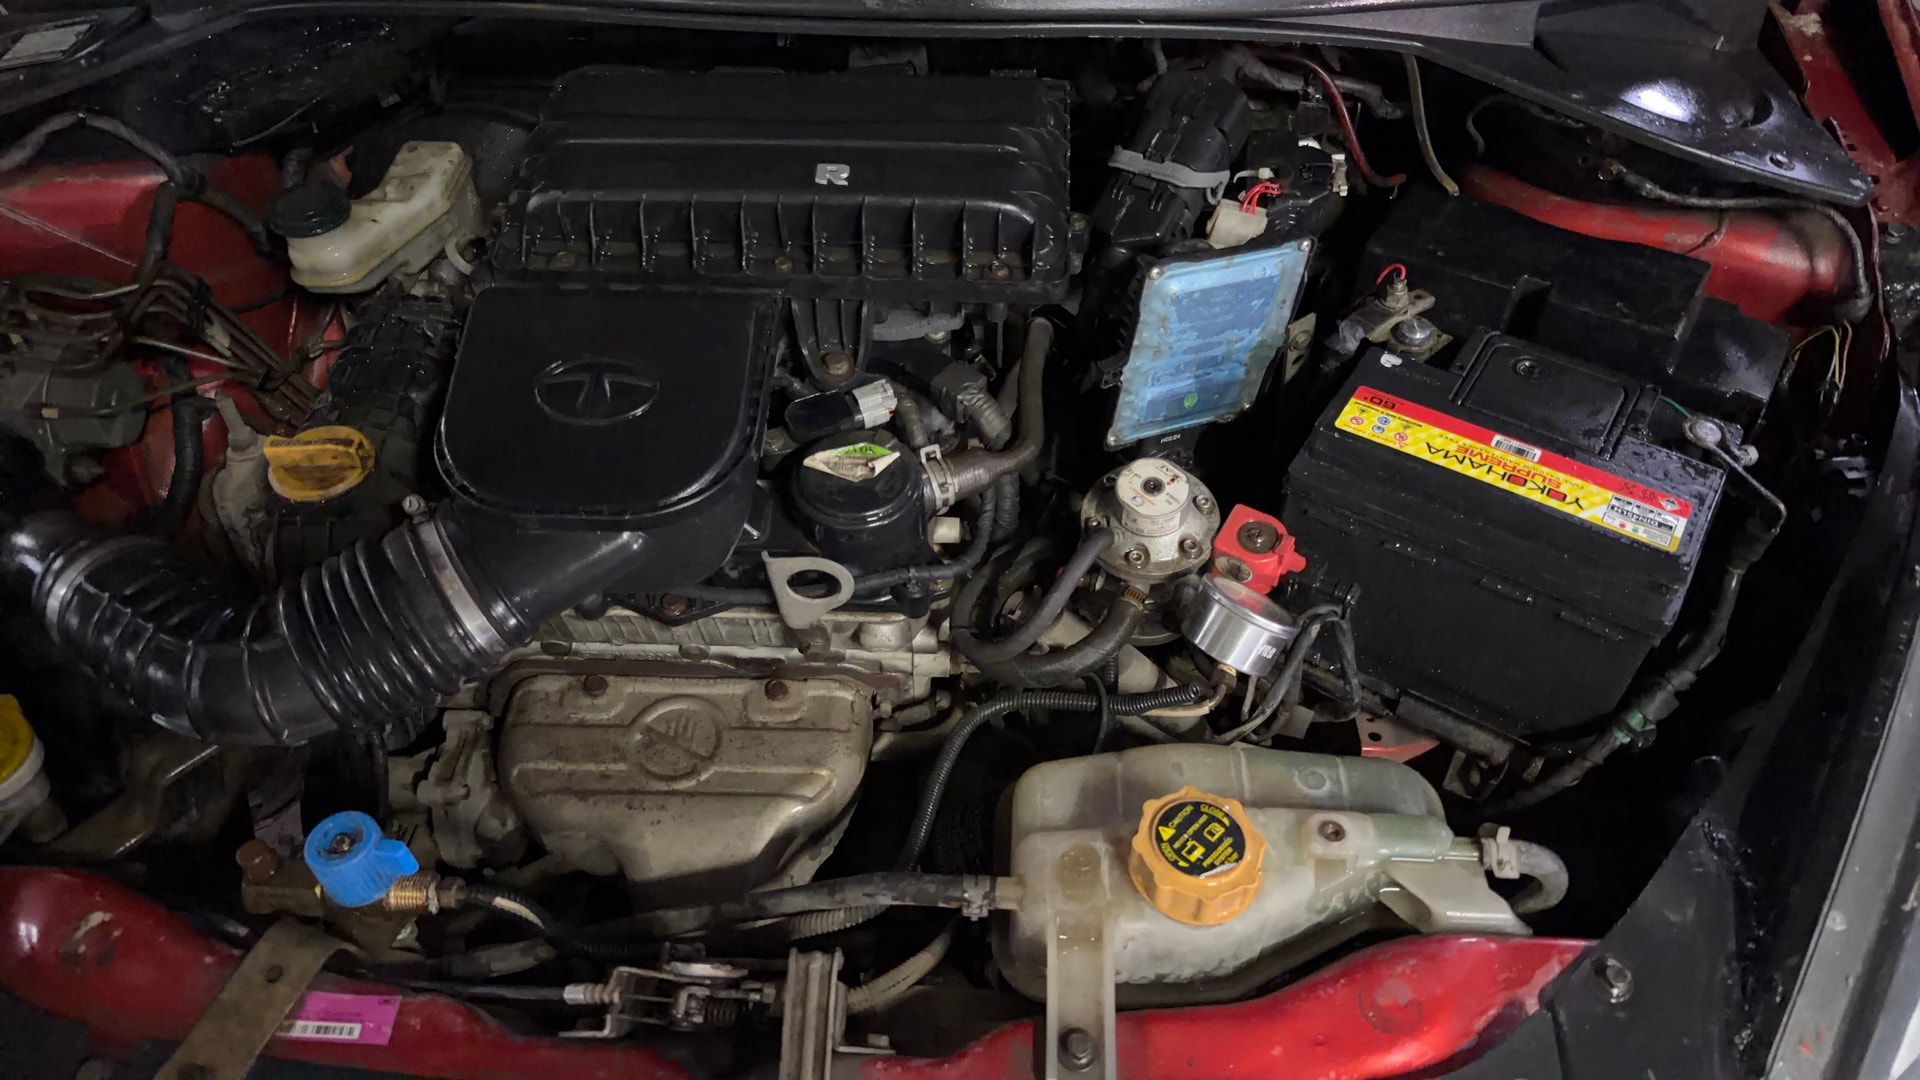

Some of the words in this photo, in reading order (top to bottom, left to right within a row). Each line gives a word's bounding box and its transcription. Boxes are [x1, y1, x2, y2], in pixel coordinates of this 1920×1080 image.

[815, 163, 850, 186] R
[1426, 442, 1584, 510] YOKOHAMA
[1456, 444, 1562, 489] SUPREME
